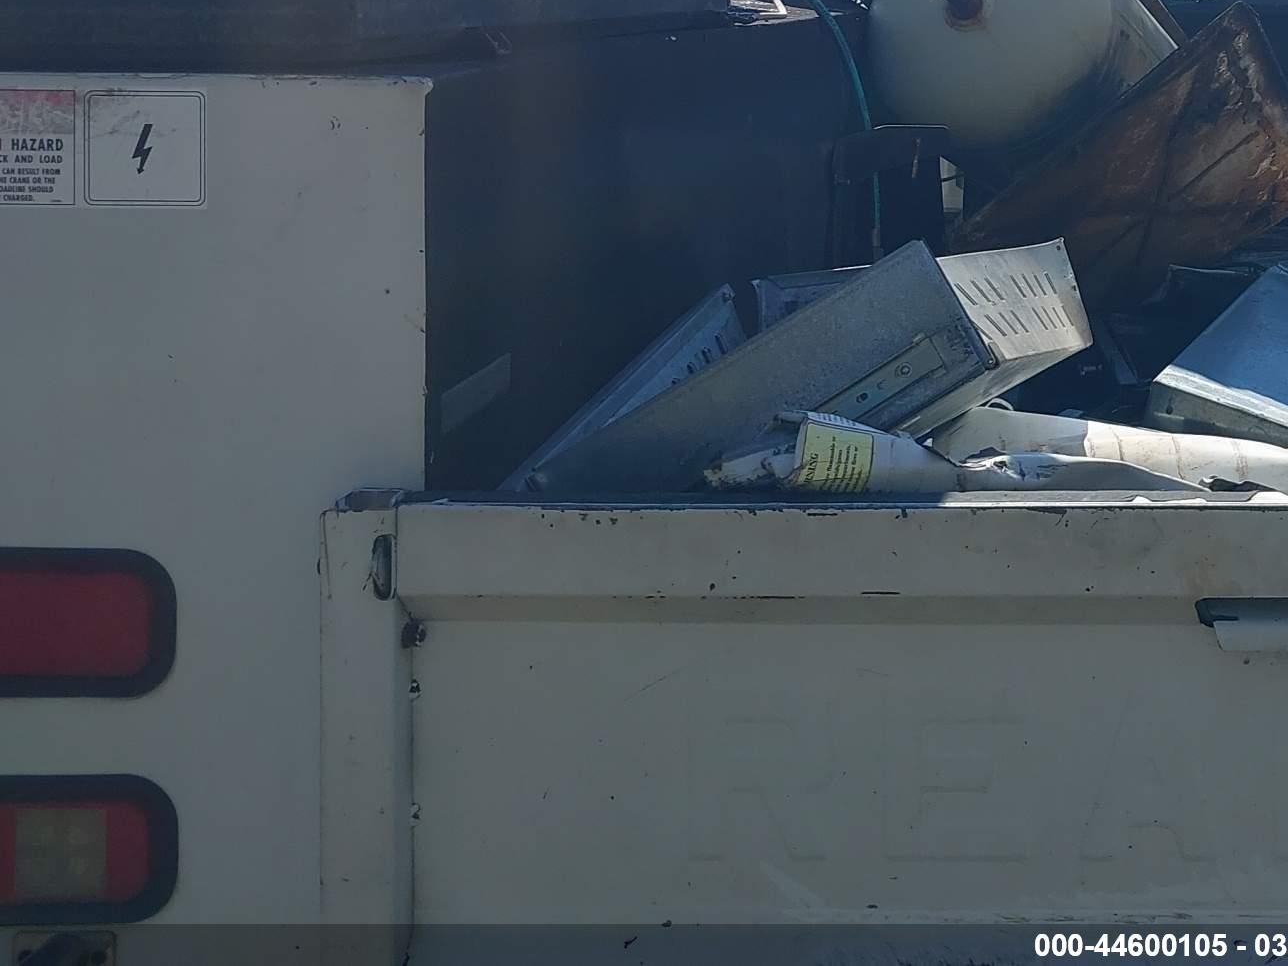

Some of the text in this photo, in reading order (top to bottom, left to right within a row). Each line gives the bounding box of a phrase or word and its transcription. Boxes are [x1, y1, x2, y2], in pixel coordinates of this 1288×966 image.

[11, 137, 64, 152] HAZARD
[14, 154, 34, 163] AND
[39, 154, 63, 164] LOAD
[42, 168, 61, 176] FROM
[803, 452, 819, 483] RNING
